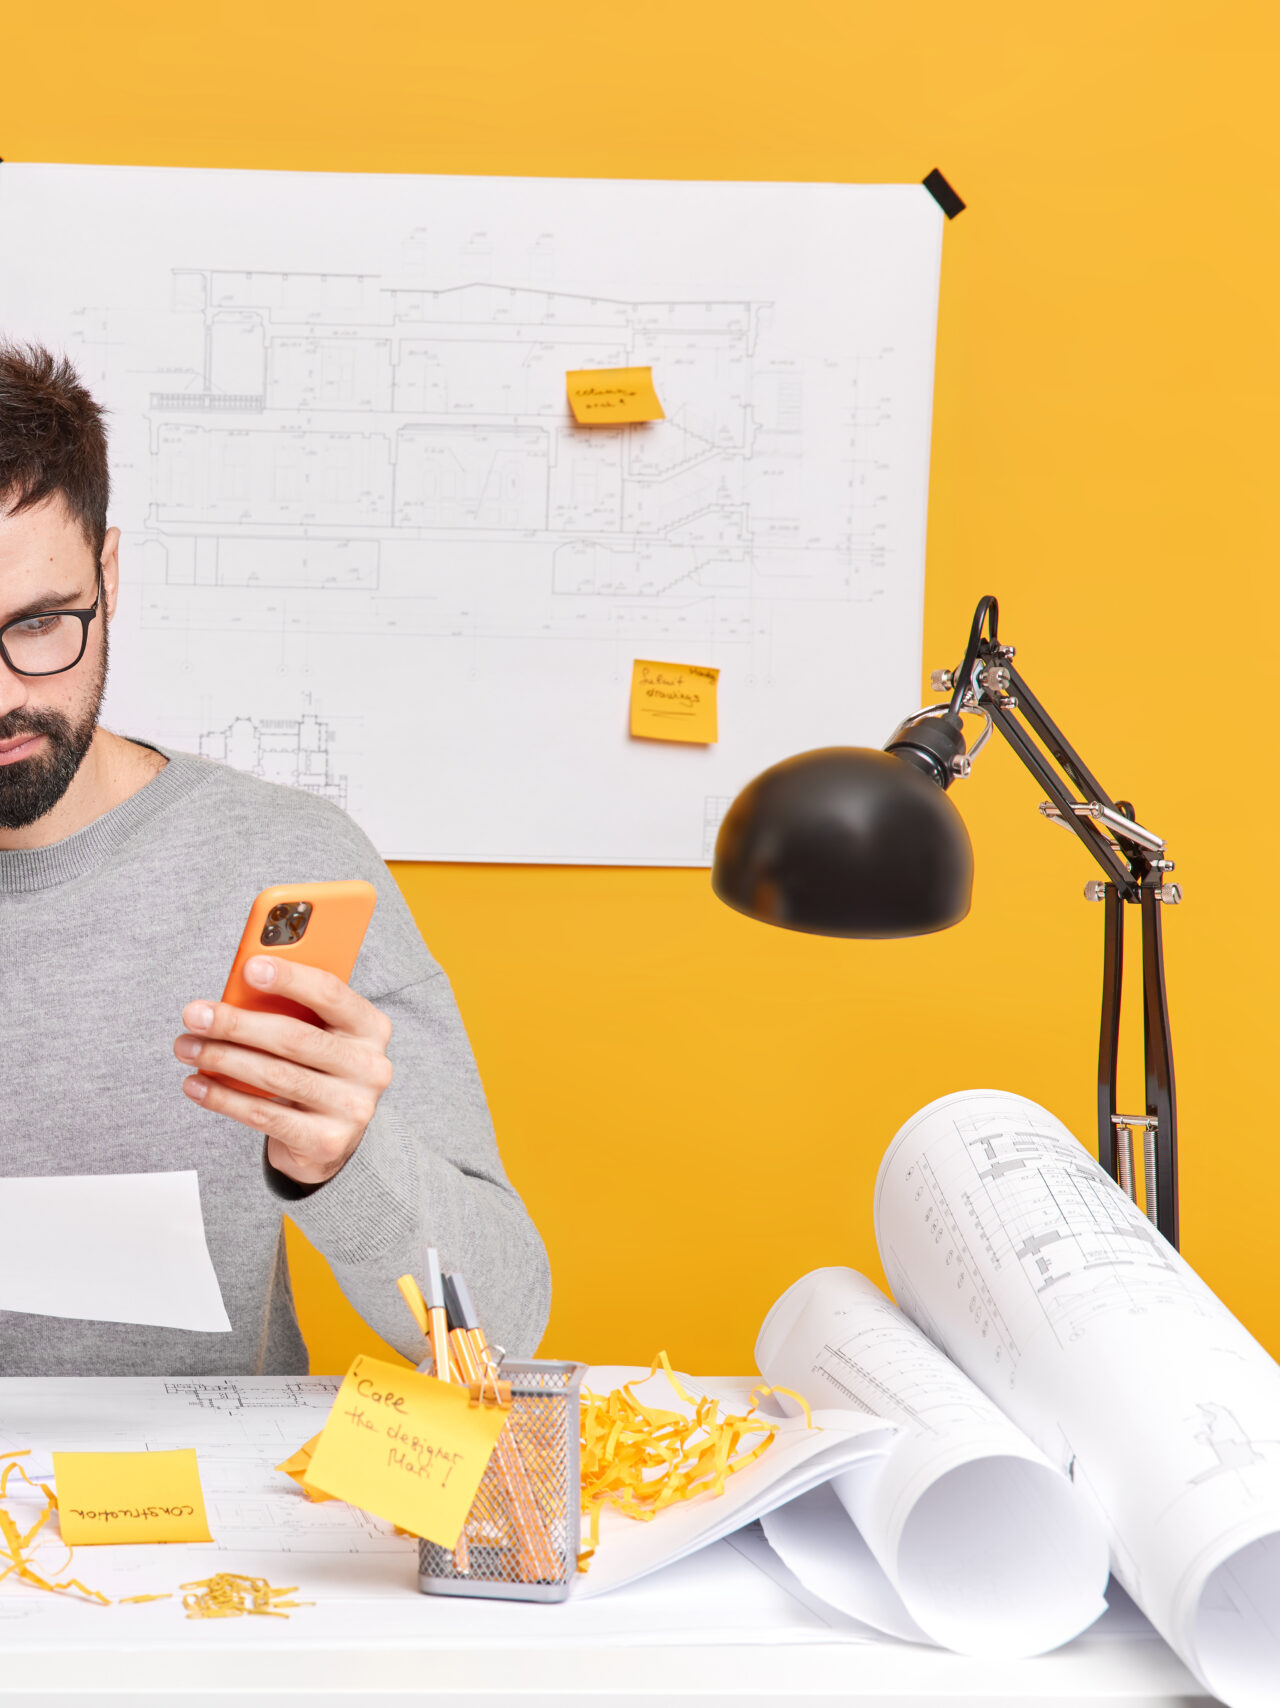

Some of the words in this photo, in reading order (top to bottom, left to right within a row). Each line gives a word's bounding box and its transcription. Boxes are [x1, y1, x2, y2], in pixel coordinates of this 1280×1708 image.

[645, 687, 700, 708] drawings
[344, 1406, 379, 1433] the
[386, 1423, 464, 1468] designer
